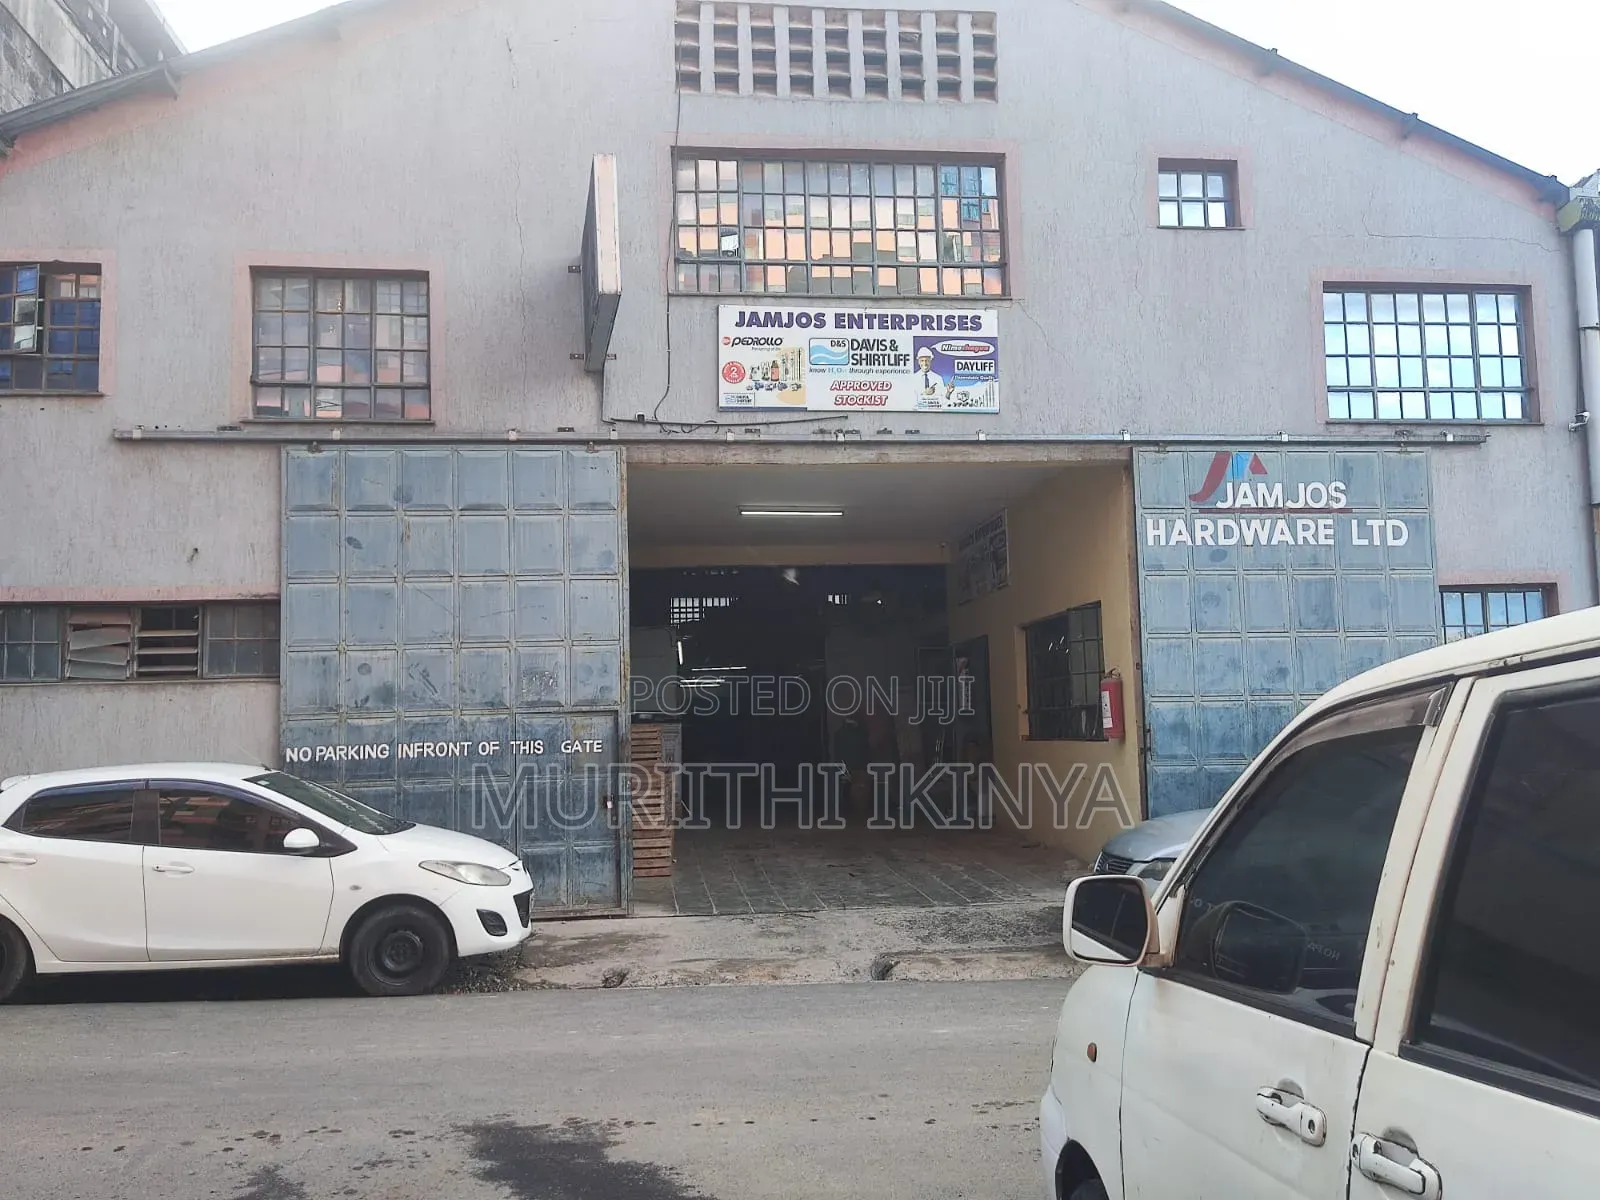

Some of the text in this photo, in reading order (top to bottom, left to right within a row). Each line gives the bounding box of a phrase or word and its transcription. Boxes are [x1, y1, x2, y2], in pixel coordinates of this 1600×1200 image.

[735, 311, 983, 332] JAMJOS ENTERPRISES
[731, 336, 783, 347] PEDROLLO
[830, 340, 847, 348] D&S
[850, 338, 899, 352] DAVIS &
[851, 353, 911, 367] SHIRTLIFF
[956, 361, 994, 372] DAYLIFF
[849, 367, 874, 376] through
[875, 367, 911, 376] experience
[830, 379, 893, 392] APPROVED
[834, 394, 889, 407] STOCKIST
[1216, 481, 1347, 509] JAMJOS
[1146, 518, 1409, 546] HARDWARE LTD
[285, 740, 603, 763] NO PARKING INFRONT OF THIS GATE
